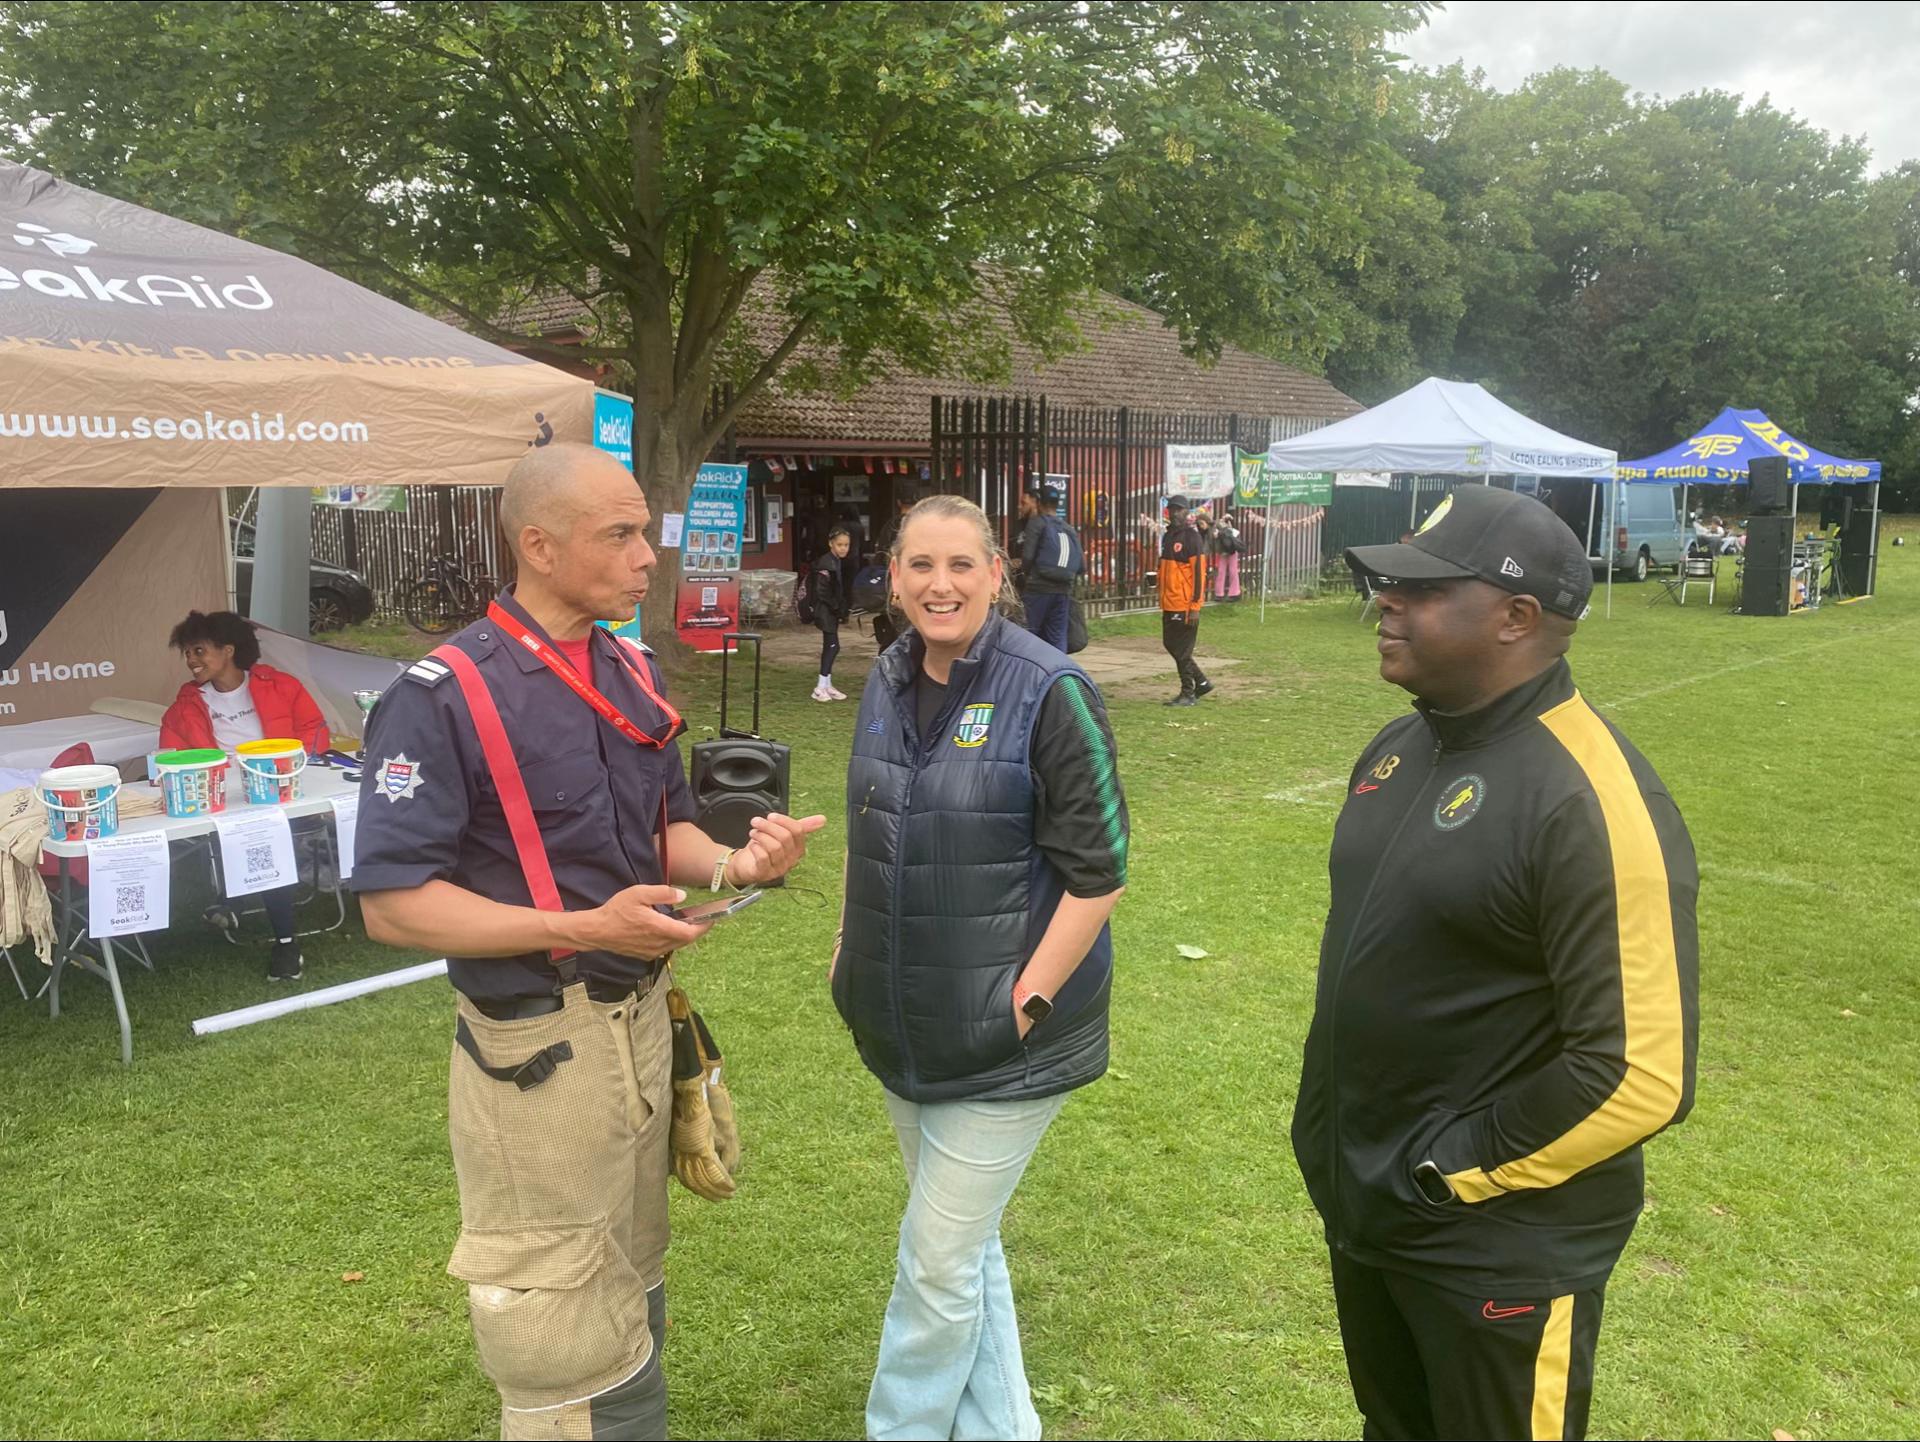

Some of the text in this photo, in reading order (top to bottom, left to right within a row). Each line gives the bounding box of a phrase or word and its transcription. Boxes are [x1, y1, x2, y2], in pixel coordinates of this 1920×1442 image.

[0, 410, 369, 442] www.seakaid.com
[1510, 452, 1603, 468] ACTON EALING WHISTLERS
[1654, 464, 1708, 479] Audio
[29, 660, 116, 683] Home
[1369, 753, 1401, 780] AB
